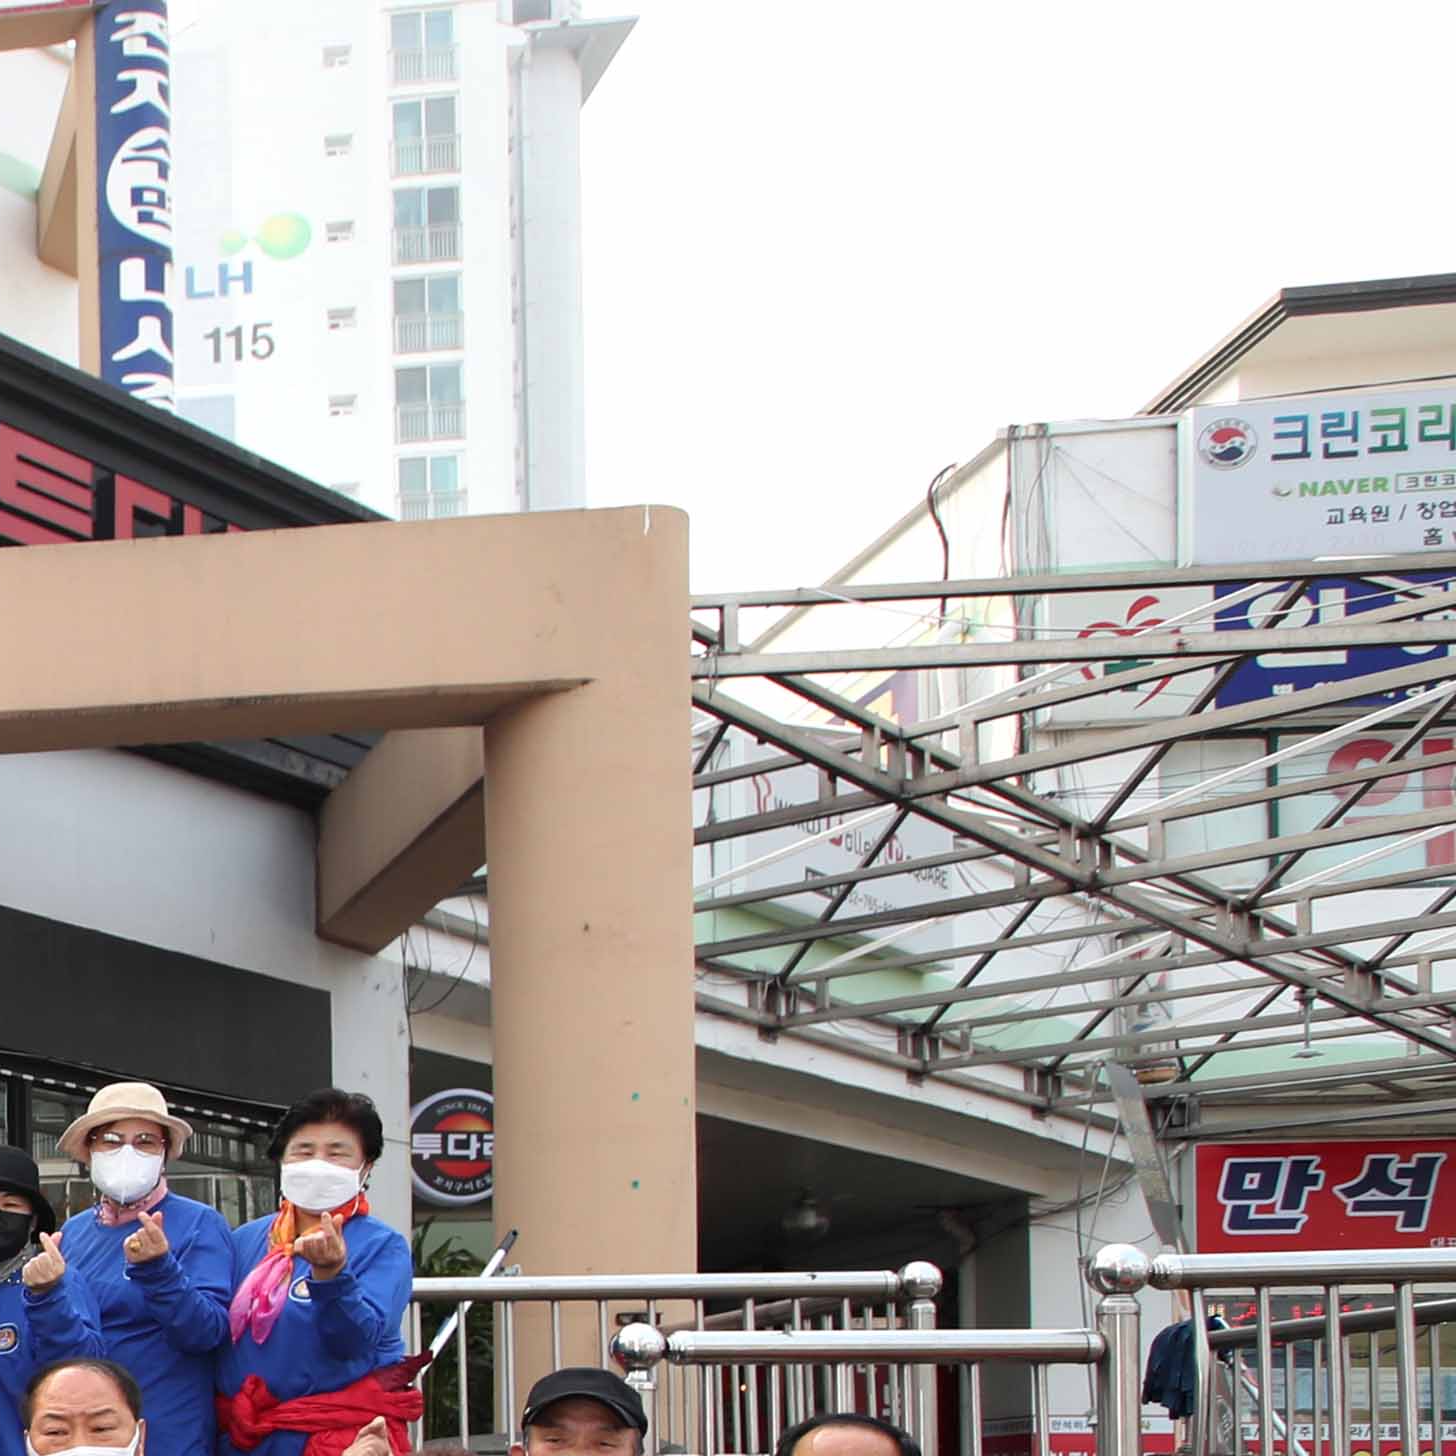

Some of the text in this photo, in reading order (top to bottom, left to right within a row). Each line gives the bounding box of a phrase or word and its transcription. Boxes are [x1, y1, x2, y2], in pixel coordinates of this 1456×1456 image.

[185, 261, 253, 299] LH
[204, 322, 275, 363] 115
[1299, 477, 1389, 497] NAVER
[1326, 505, 1389, 525] 교육원
